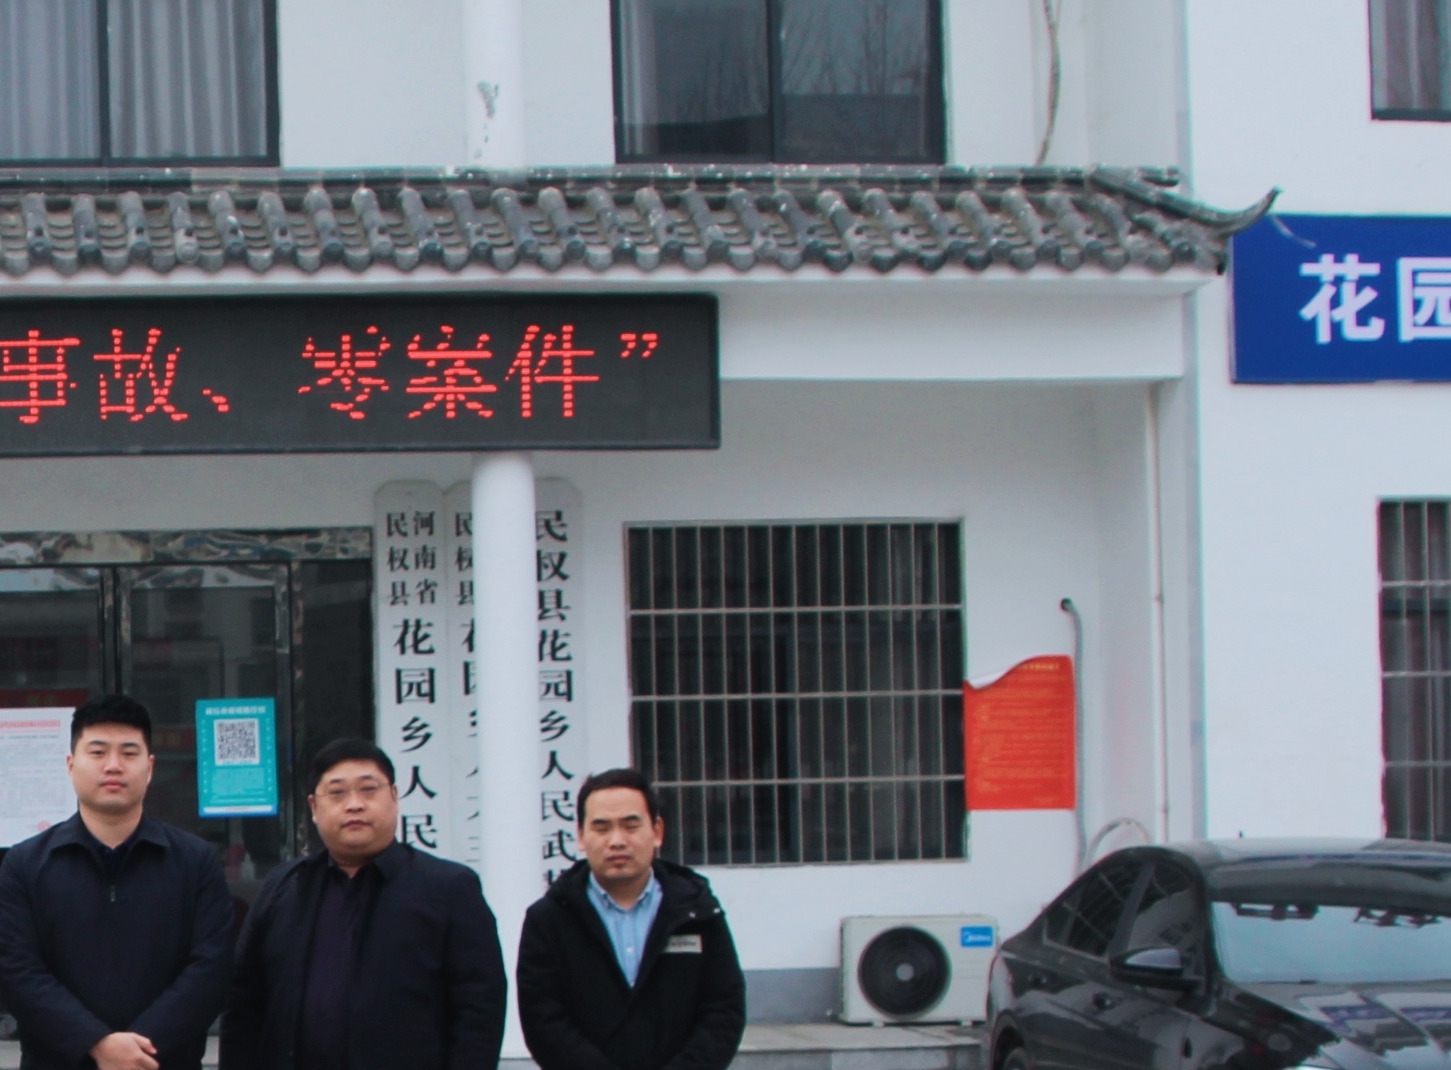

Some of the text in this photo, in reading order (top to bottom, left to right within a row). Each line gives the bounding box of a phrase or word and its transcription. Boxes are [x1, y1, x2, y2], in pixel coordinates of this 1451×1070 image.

[1298, 253, 1451, 344] 花园
[386, 512, 410, 606] 民权县
[413, 511, 438, 605] 河南省
[393, 618, 438, 850] 花园乡人民
